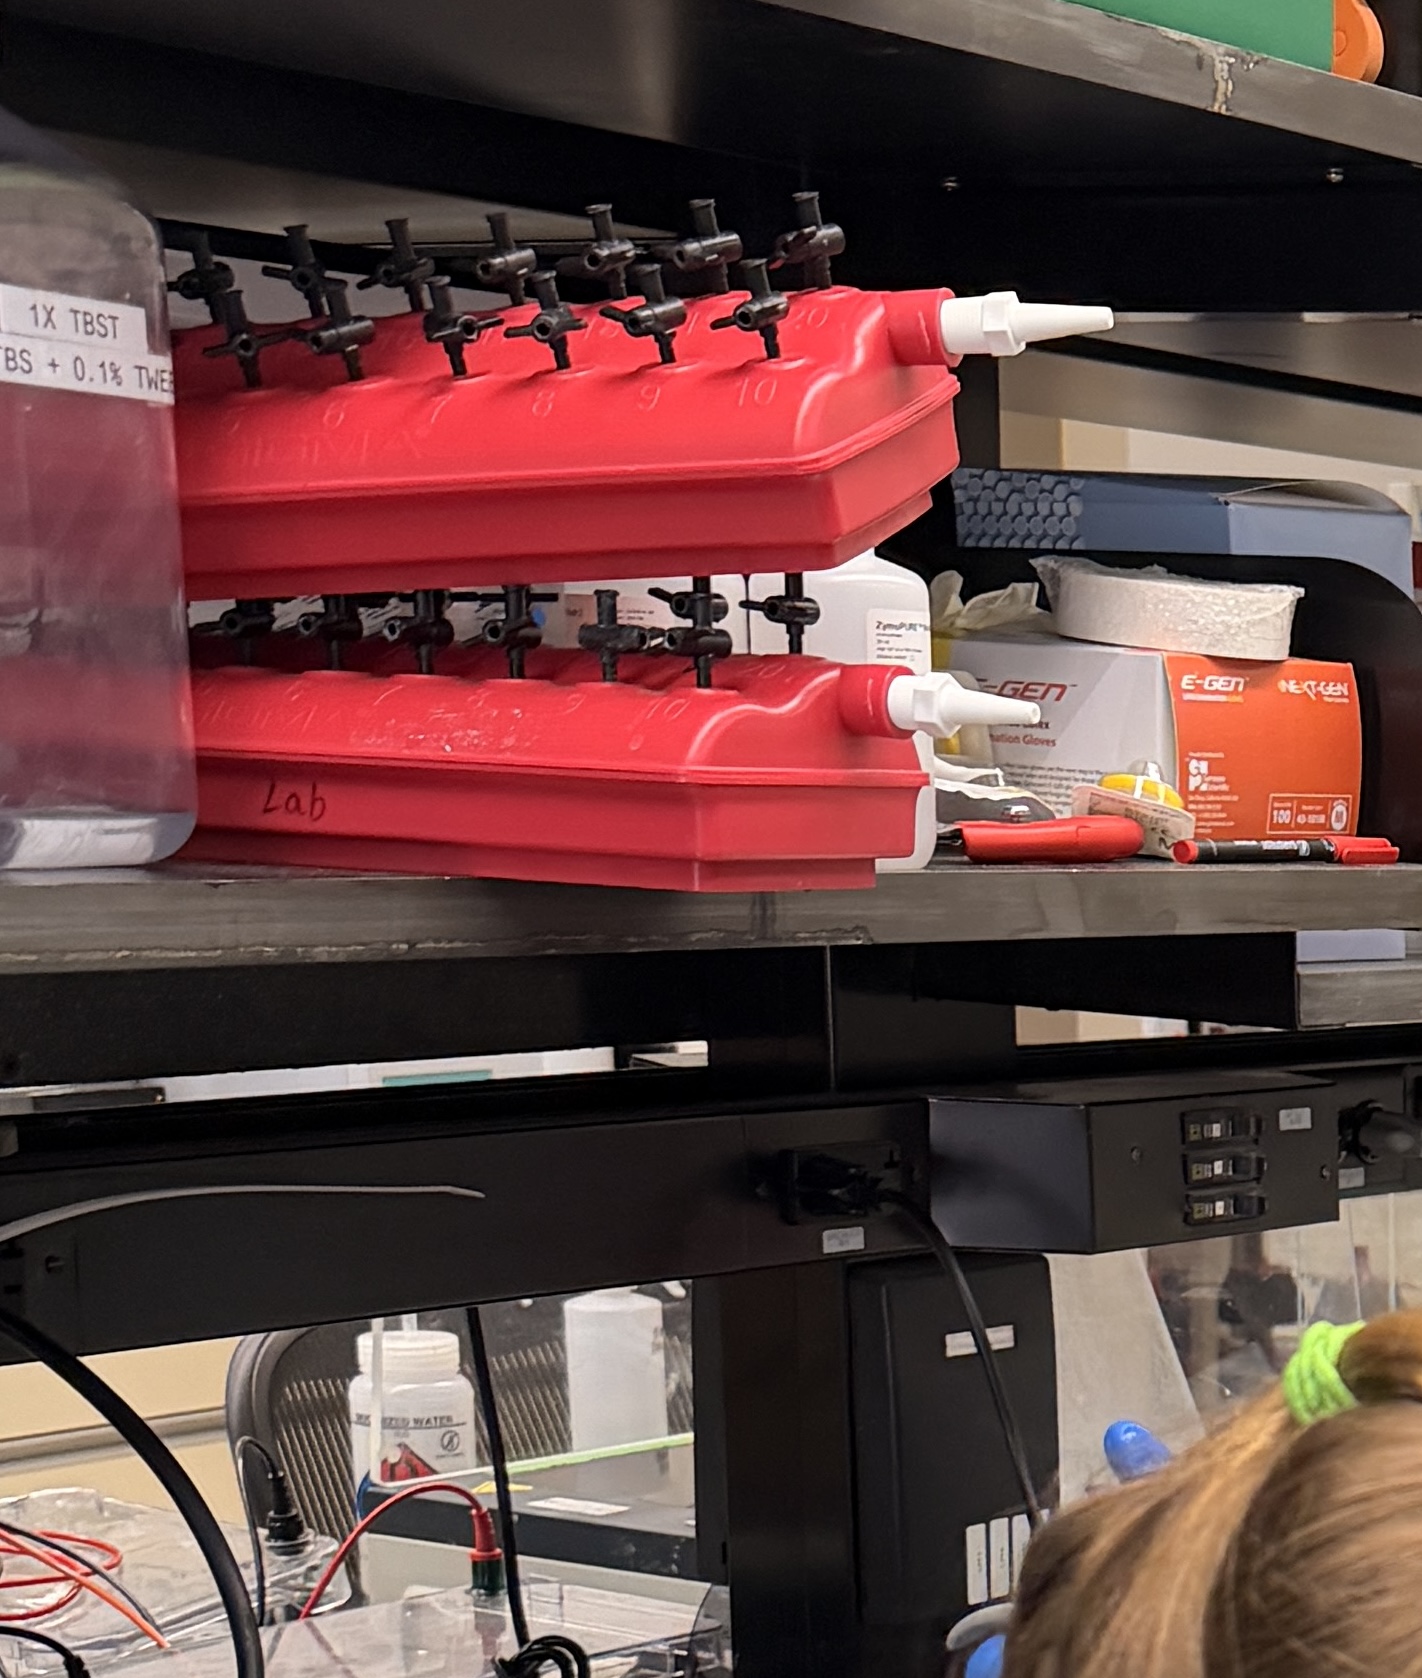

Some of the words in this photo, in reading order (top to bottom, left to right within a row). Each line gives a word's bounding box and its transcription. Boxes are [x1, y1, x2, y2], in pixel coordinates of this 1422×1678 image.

[29, 303, 57, 331] 1X
[69, 307, 120, 339] TBST
[0, 346, 34, 375] BS
[73, 355, 123, 387] 0.1%
[737, 376, 777, 407] 10
[976, 679, 1068, 702] -GEN
[1181, 674, 1245, 692] E-GEN
[1023, 734, 1057, 748] Gloves
[263, 782, 326, 821] Lab
